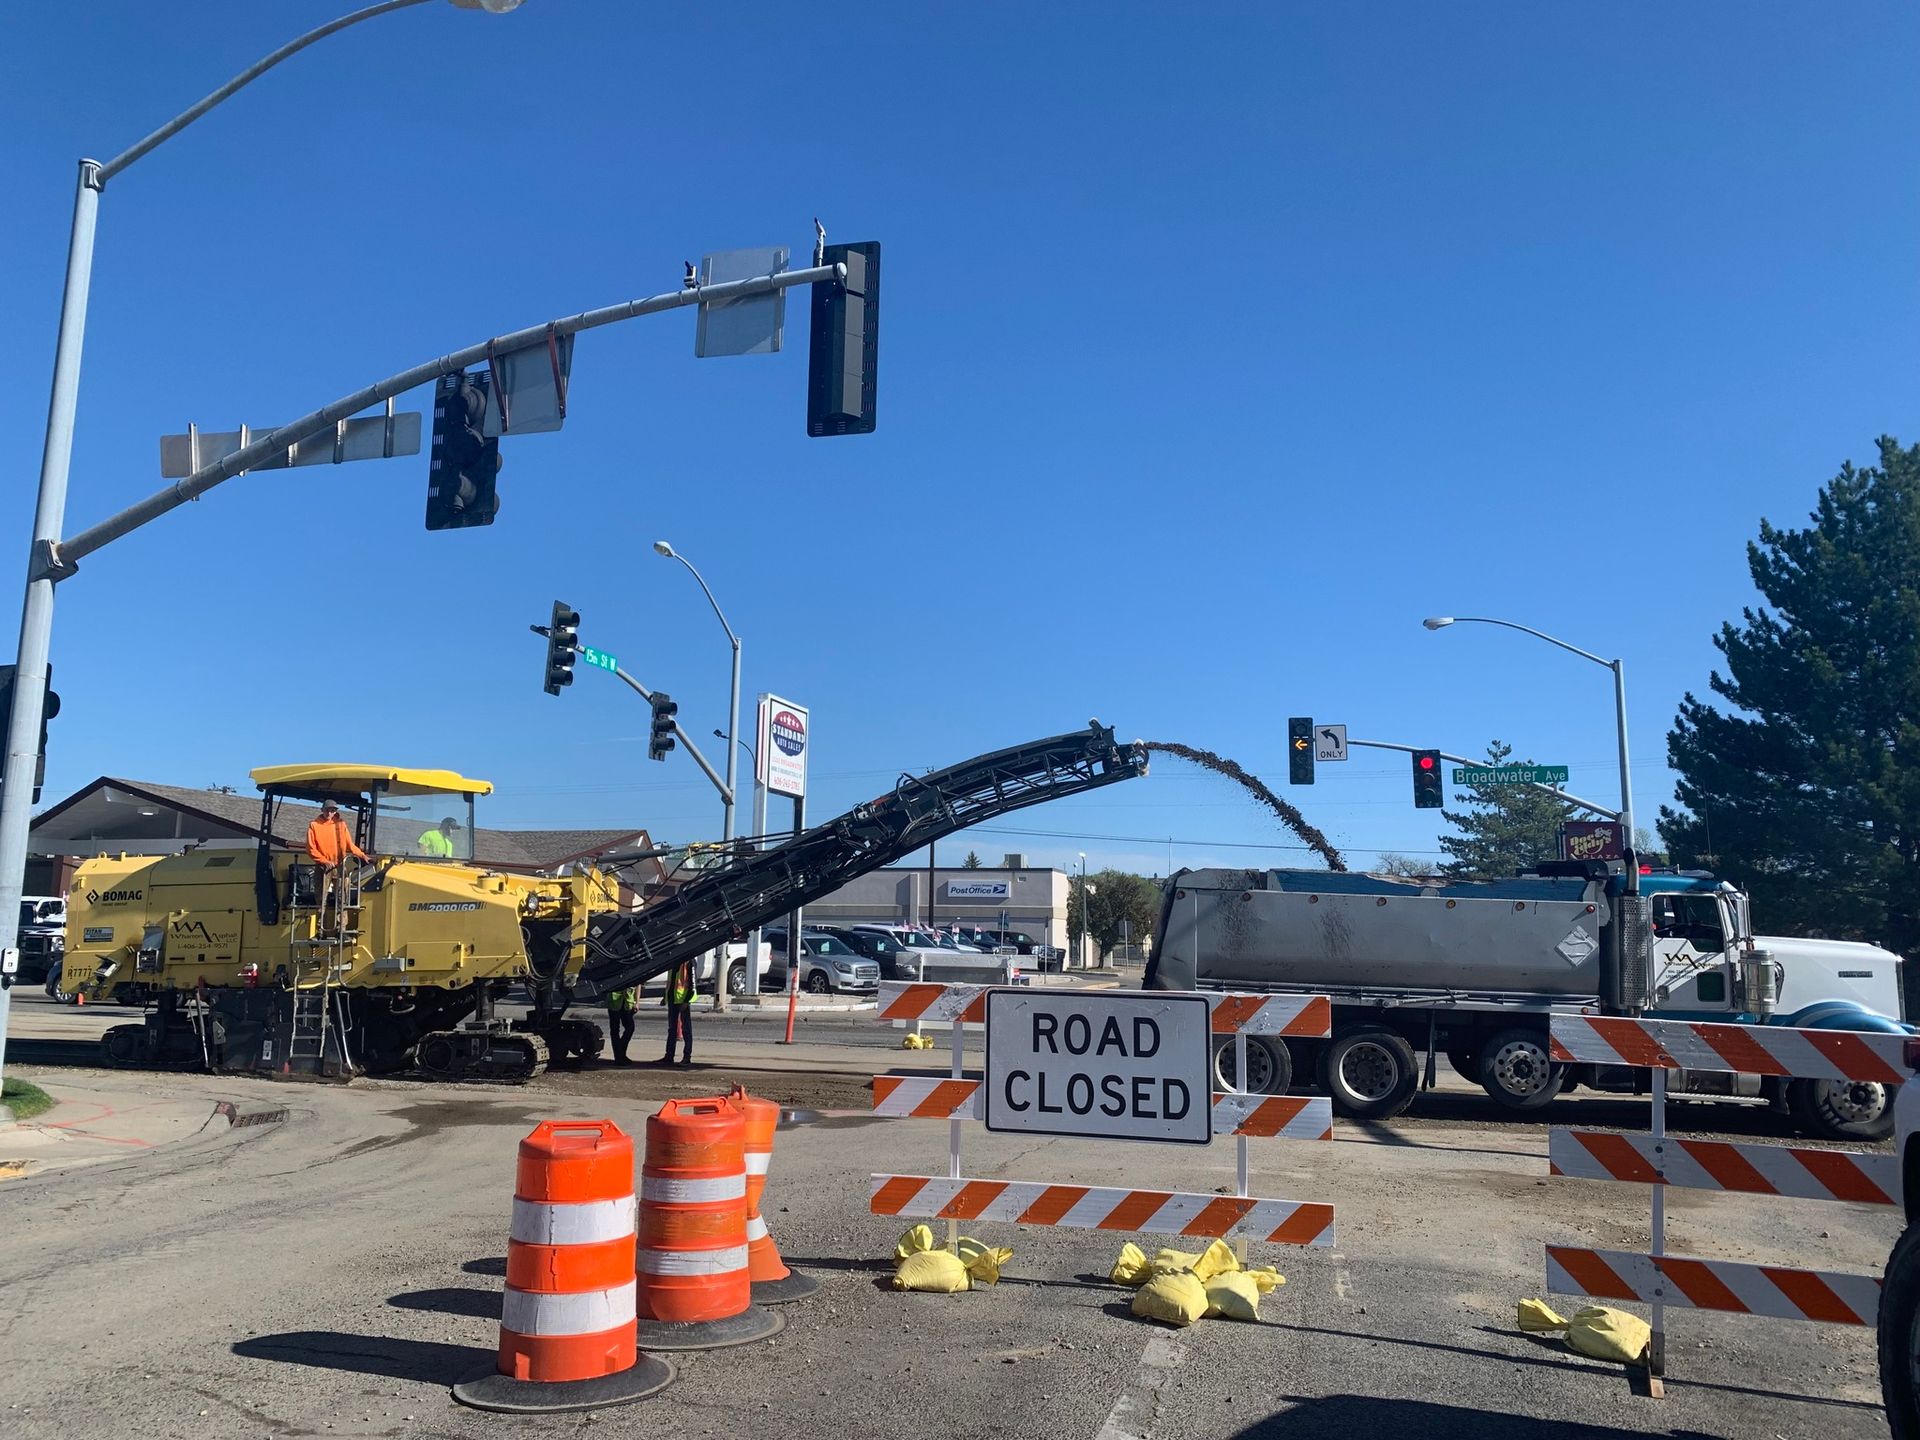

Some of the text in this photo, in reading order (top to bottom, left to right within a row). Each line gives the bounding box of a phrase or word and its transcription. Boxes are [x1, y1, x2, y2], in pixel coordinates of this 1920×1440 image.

[772, 724, 805, 744] STANDARD
[777, 737, 801, 753] AUTO SALES
[1320, 750, 1344, 759] ONLY
[1456, 769, 1566, 783] Broadwater Ave
[102, 890, 142, 902] BOMAG
[67, 968, 92, 977] R7777
[1033, 1013, 1161, 1058] ROAD
[1005, 1070, 1191, 1121] CLOSED
